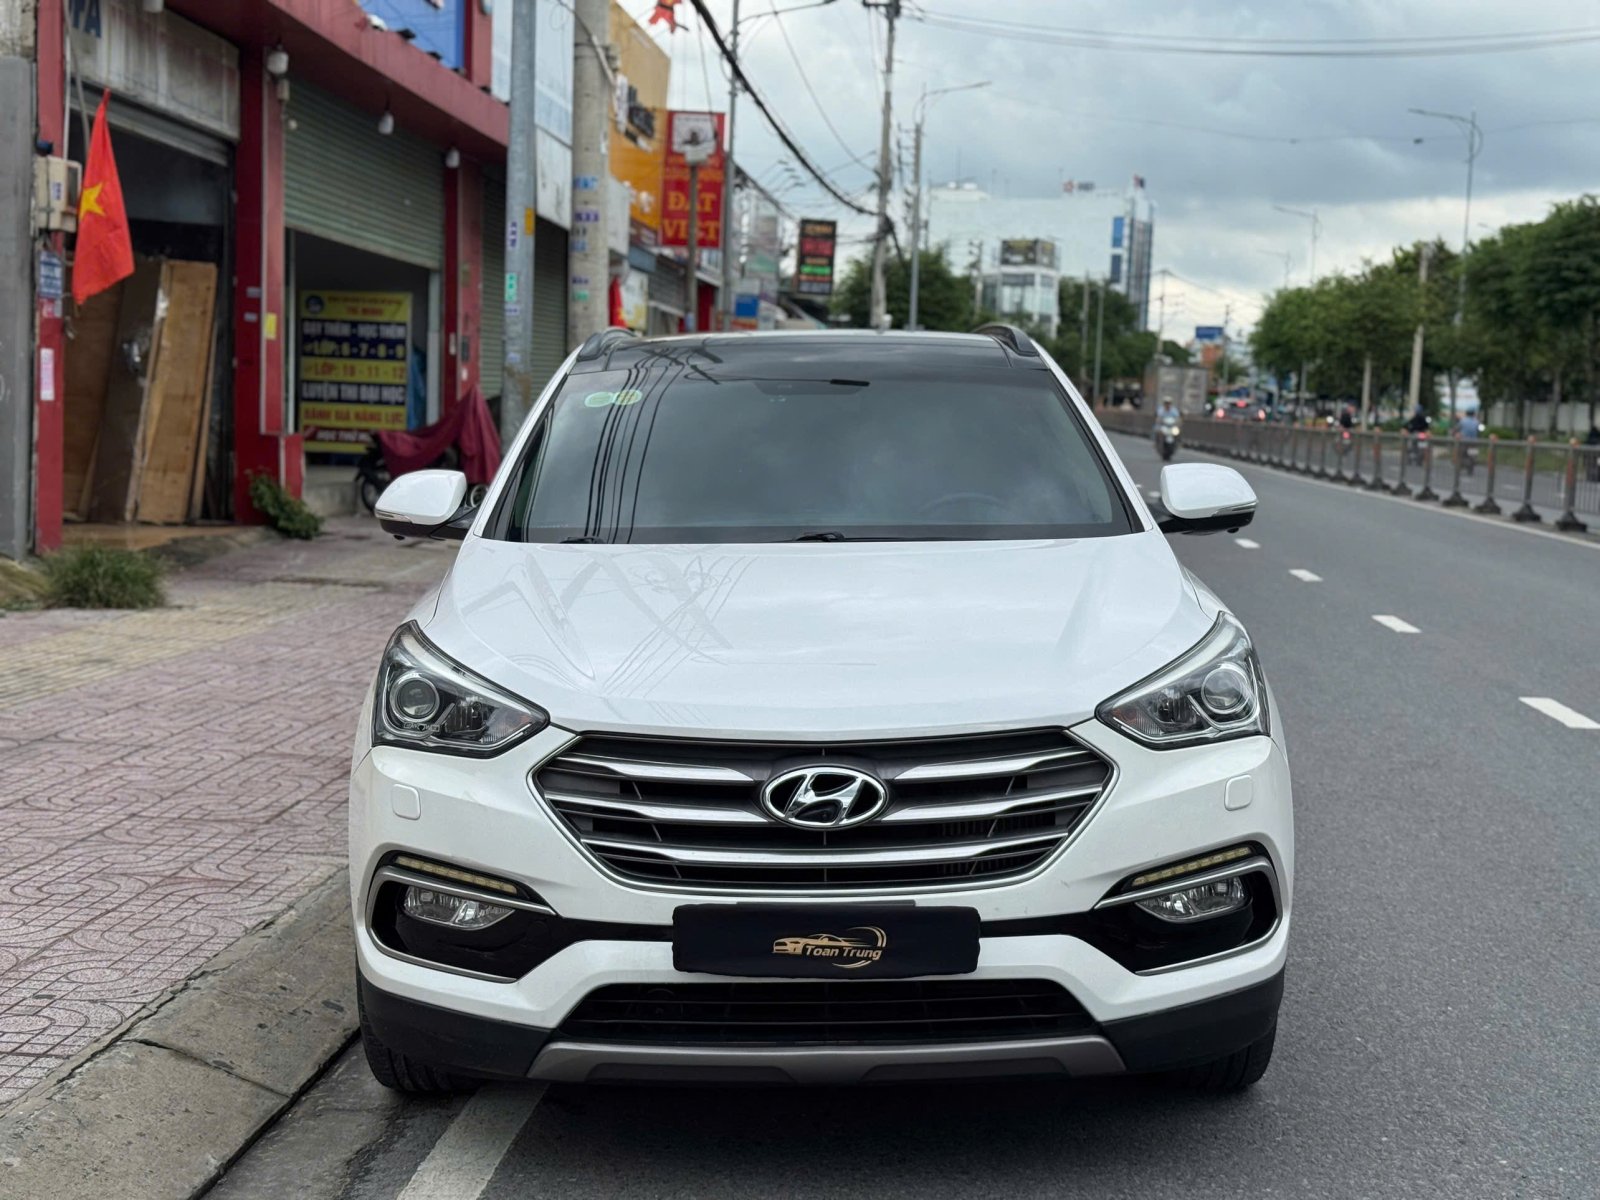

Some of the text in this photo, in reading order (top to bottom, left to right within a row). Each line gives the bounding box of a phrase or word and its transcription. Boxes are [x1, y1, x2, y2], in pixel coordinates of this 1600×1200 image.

[360, 342, 369, 358] 7
[367, 364, 379, 379] 11
[392, 365, 405, 380] 12
[381, 384, 405, 405] HỌC
[805, 945, 883, 961] Toan Trung
